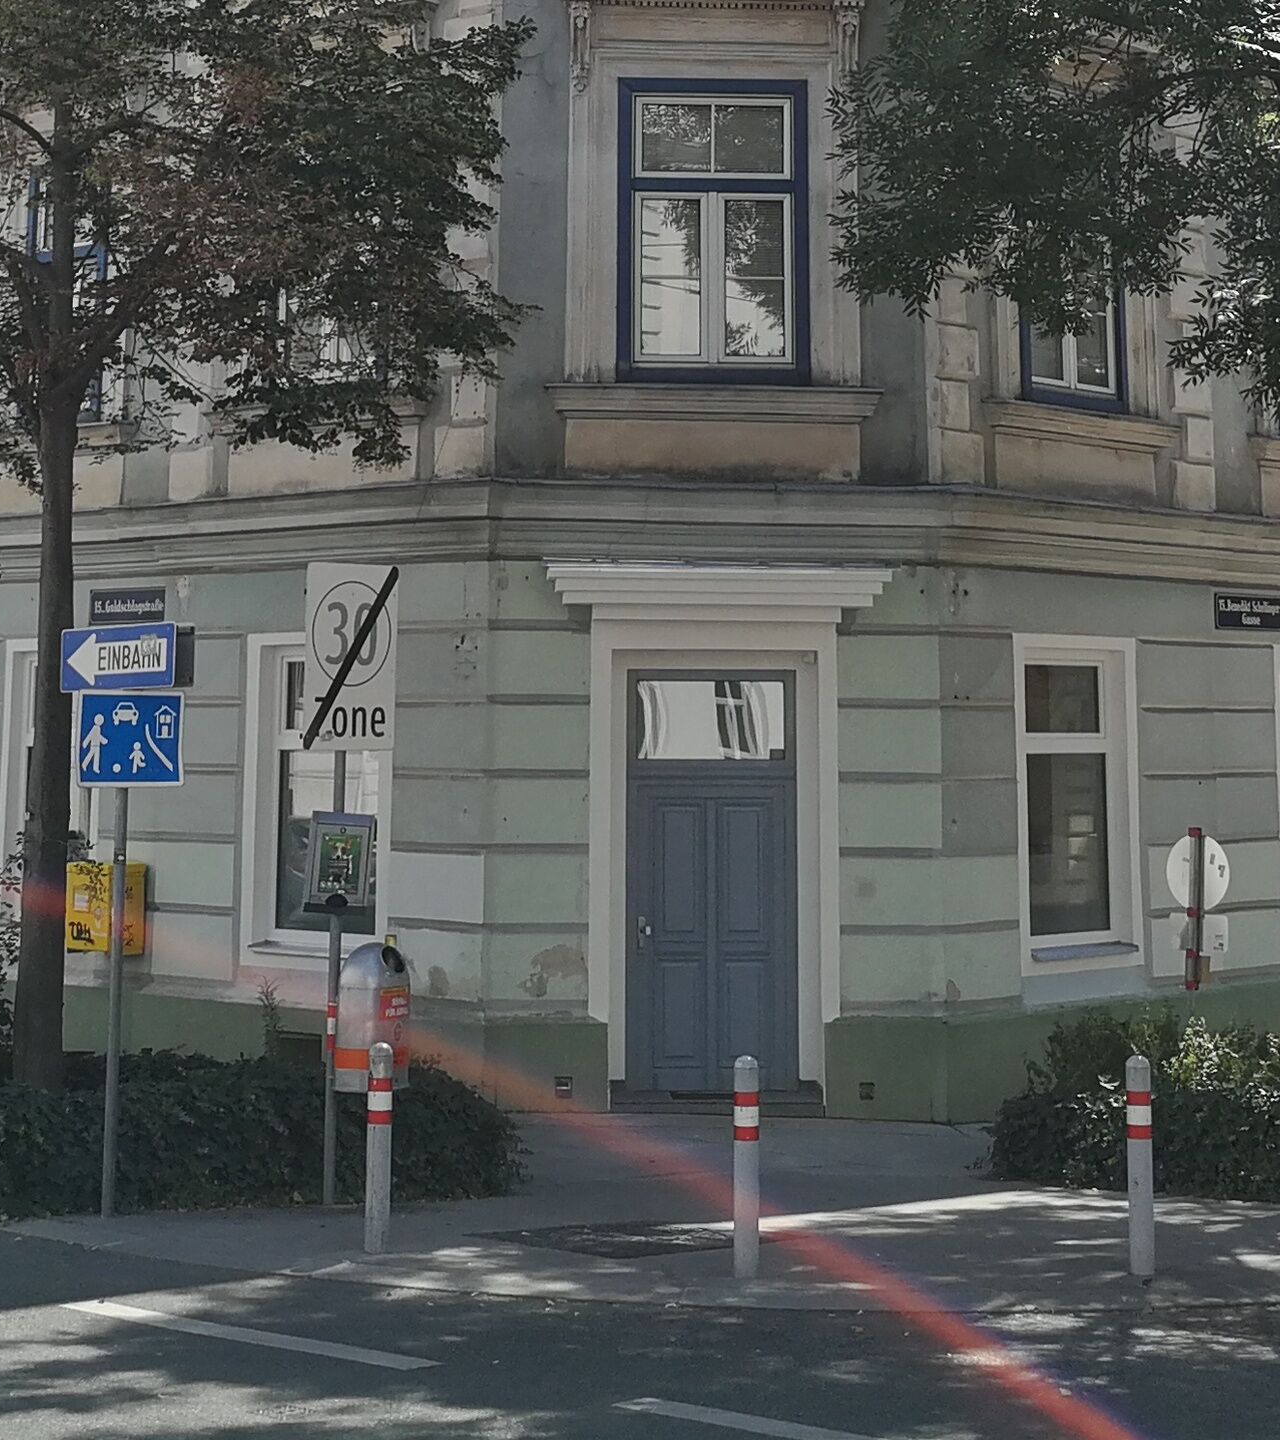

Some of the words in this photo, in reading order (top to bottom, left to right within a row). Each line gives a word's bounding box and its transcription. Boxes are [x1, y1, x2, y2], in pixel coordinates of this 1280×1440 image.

[1241, 613, 1261, 625] Gasse
[325, 602, 377, 666] 30
[98, 642, 162, 671] EINBAHN
